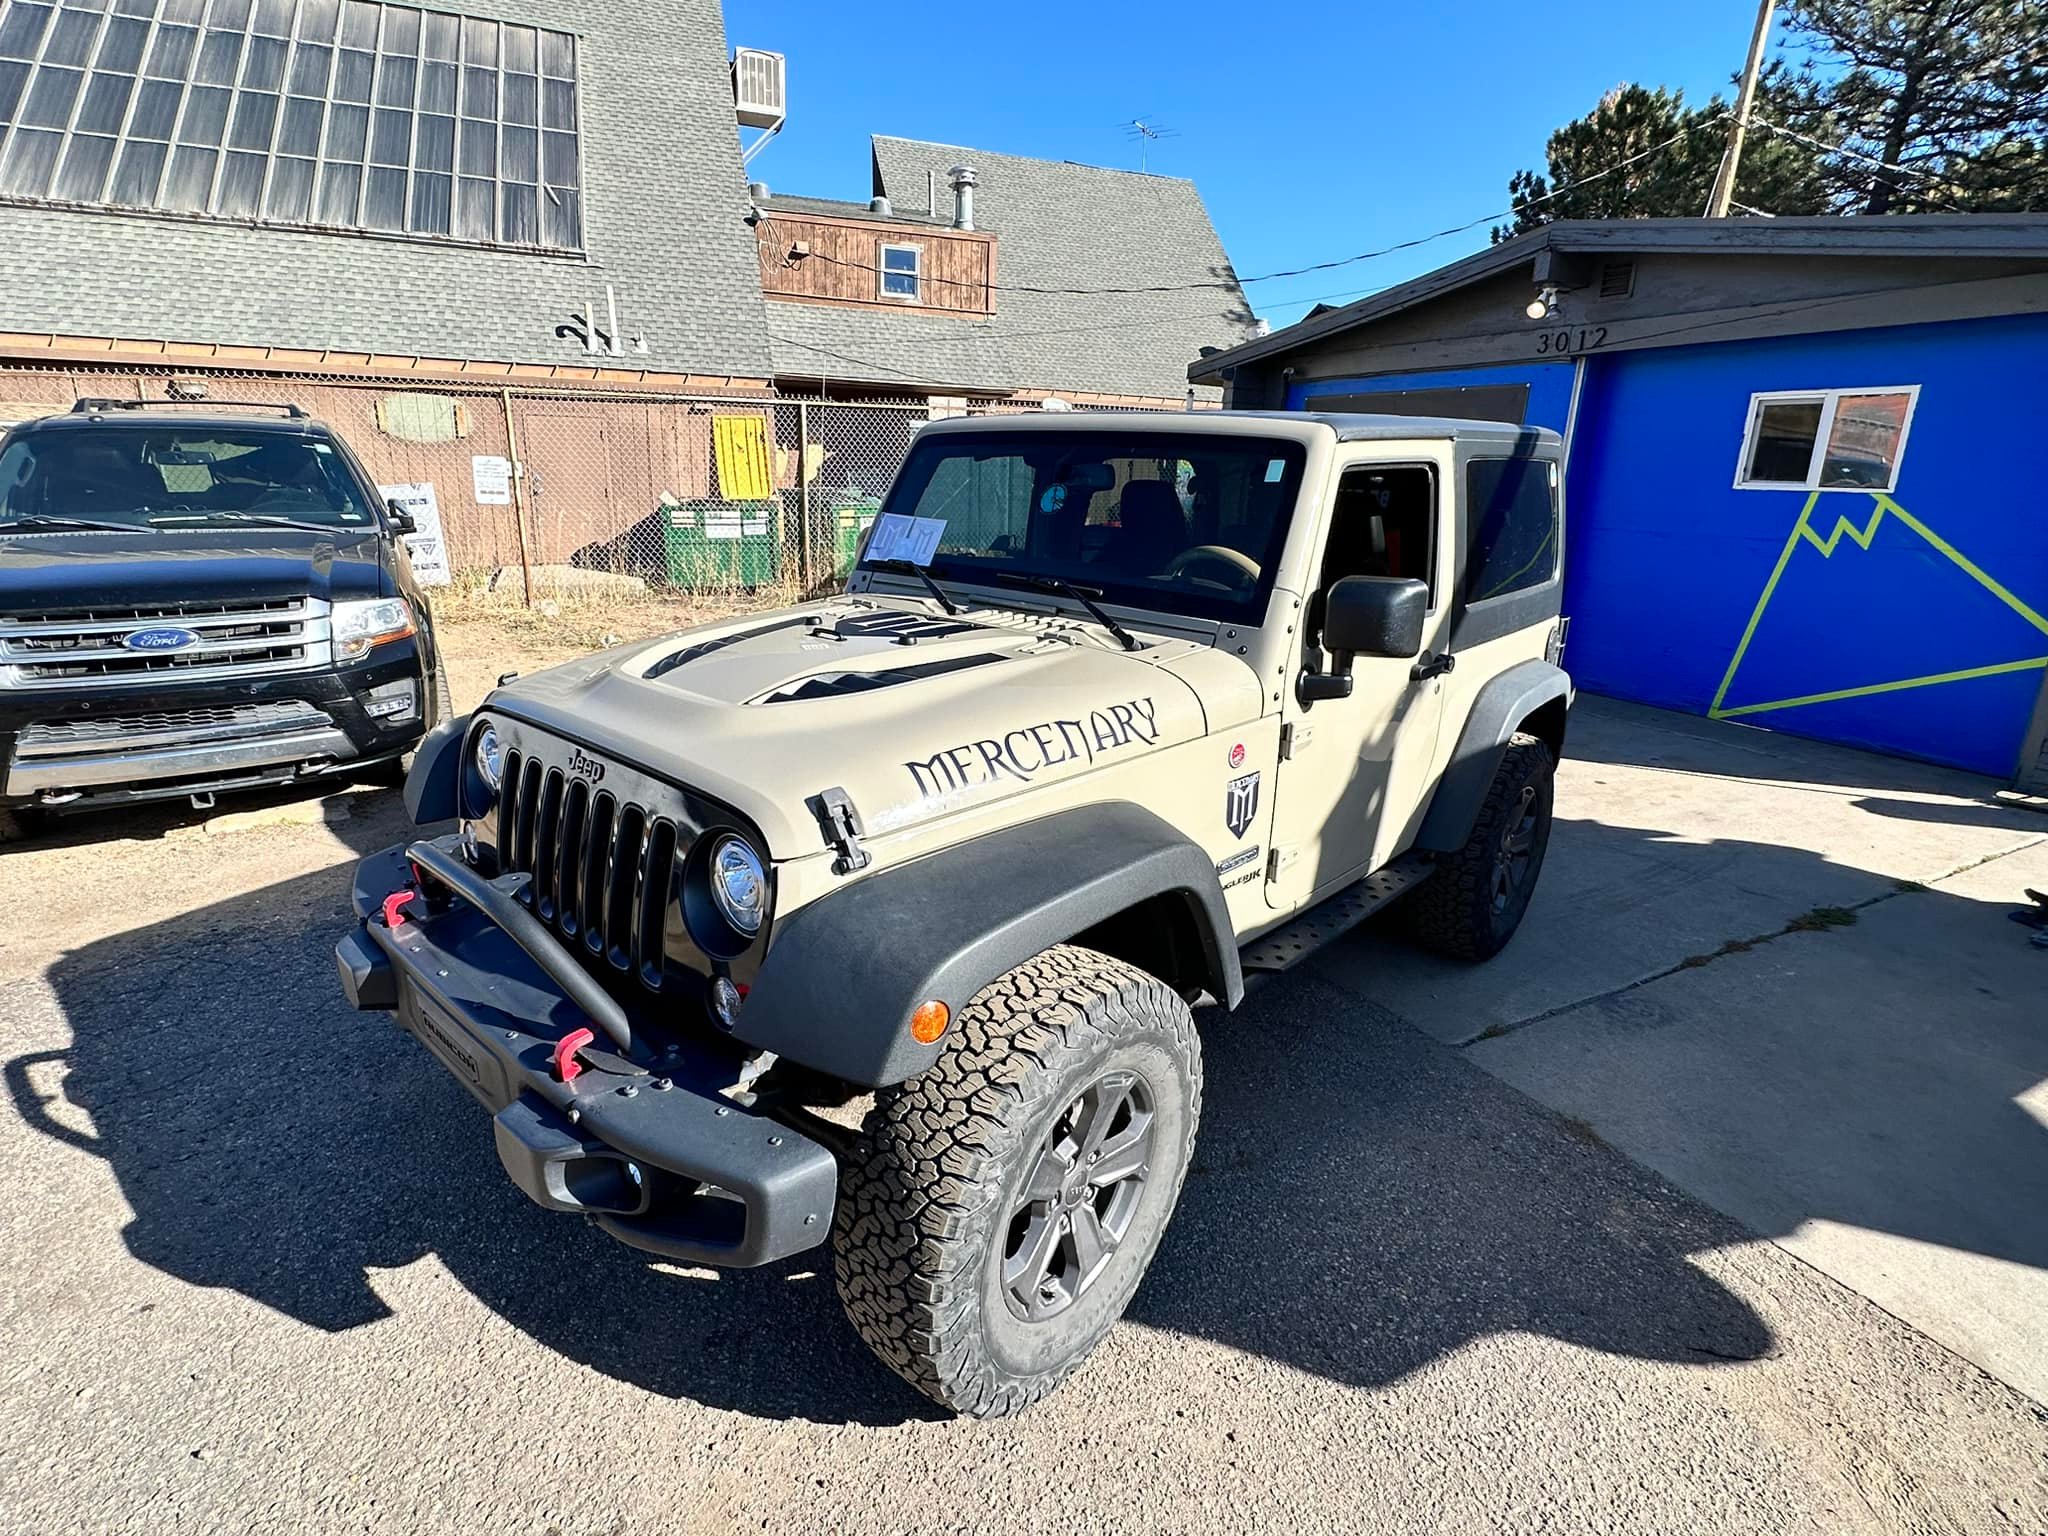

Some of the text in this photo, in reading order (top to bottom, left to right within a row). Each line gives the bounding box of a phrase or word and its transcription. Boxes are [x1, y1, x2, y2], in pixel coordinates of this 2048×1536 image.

[1537, 327, 1607, 354] 3012
[140, 632, 179, 647] Ford
[901, 697, 1160, 798] MERCENARY
[568, 748, 606, 784] Jeep
